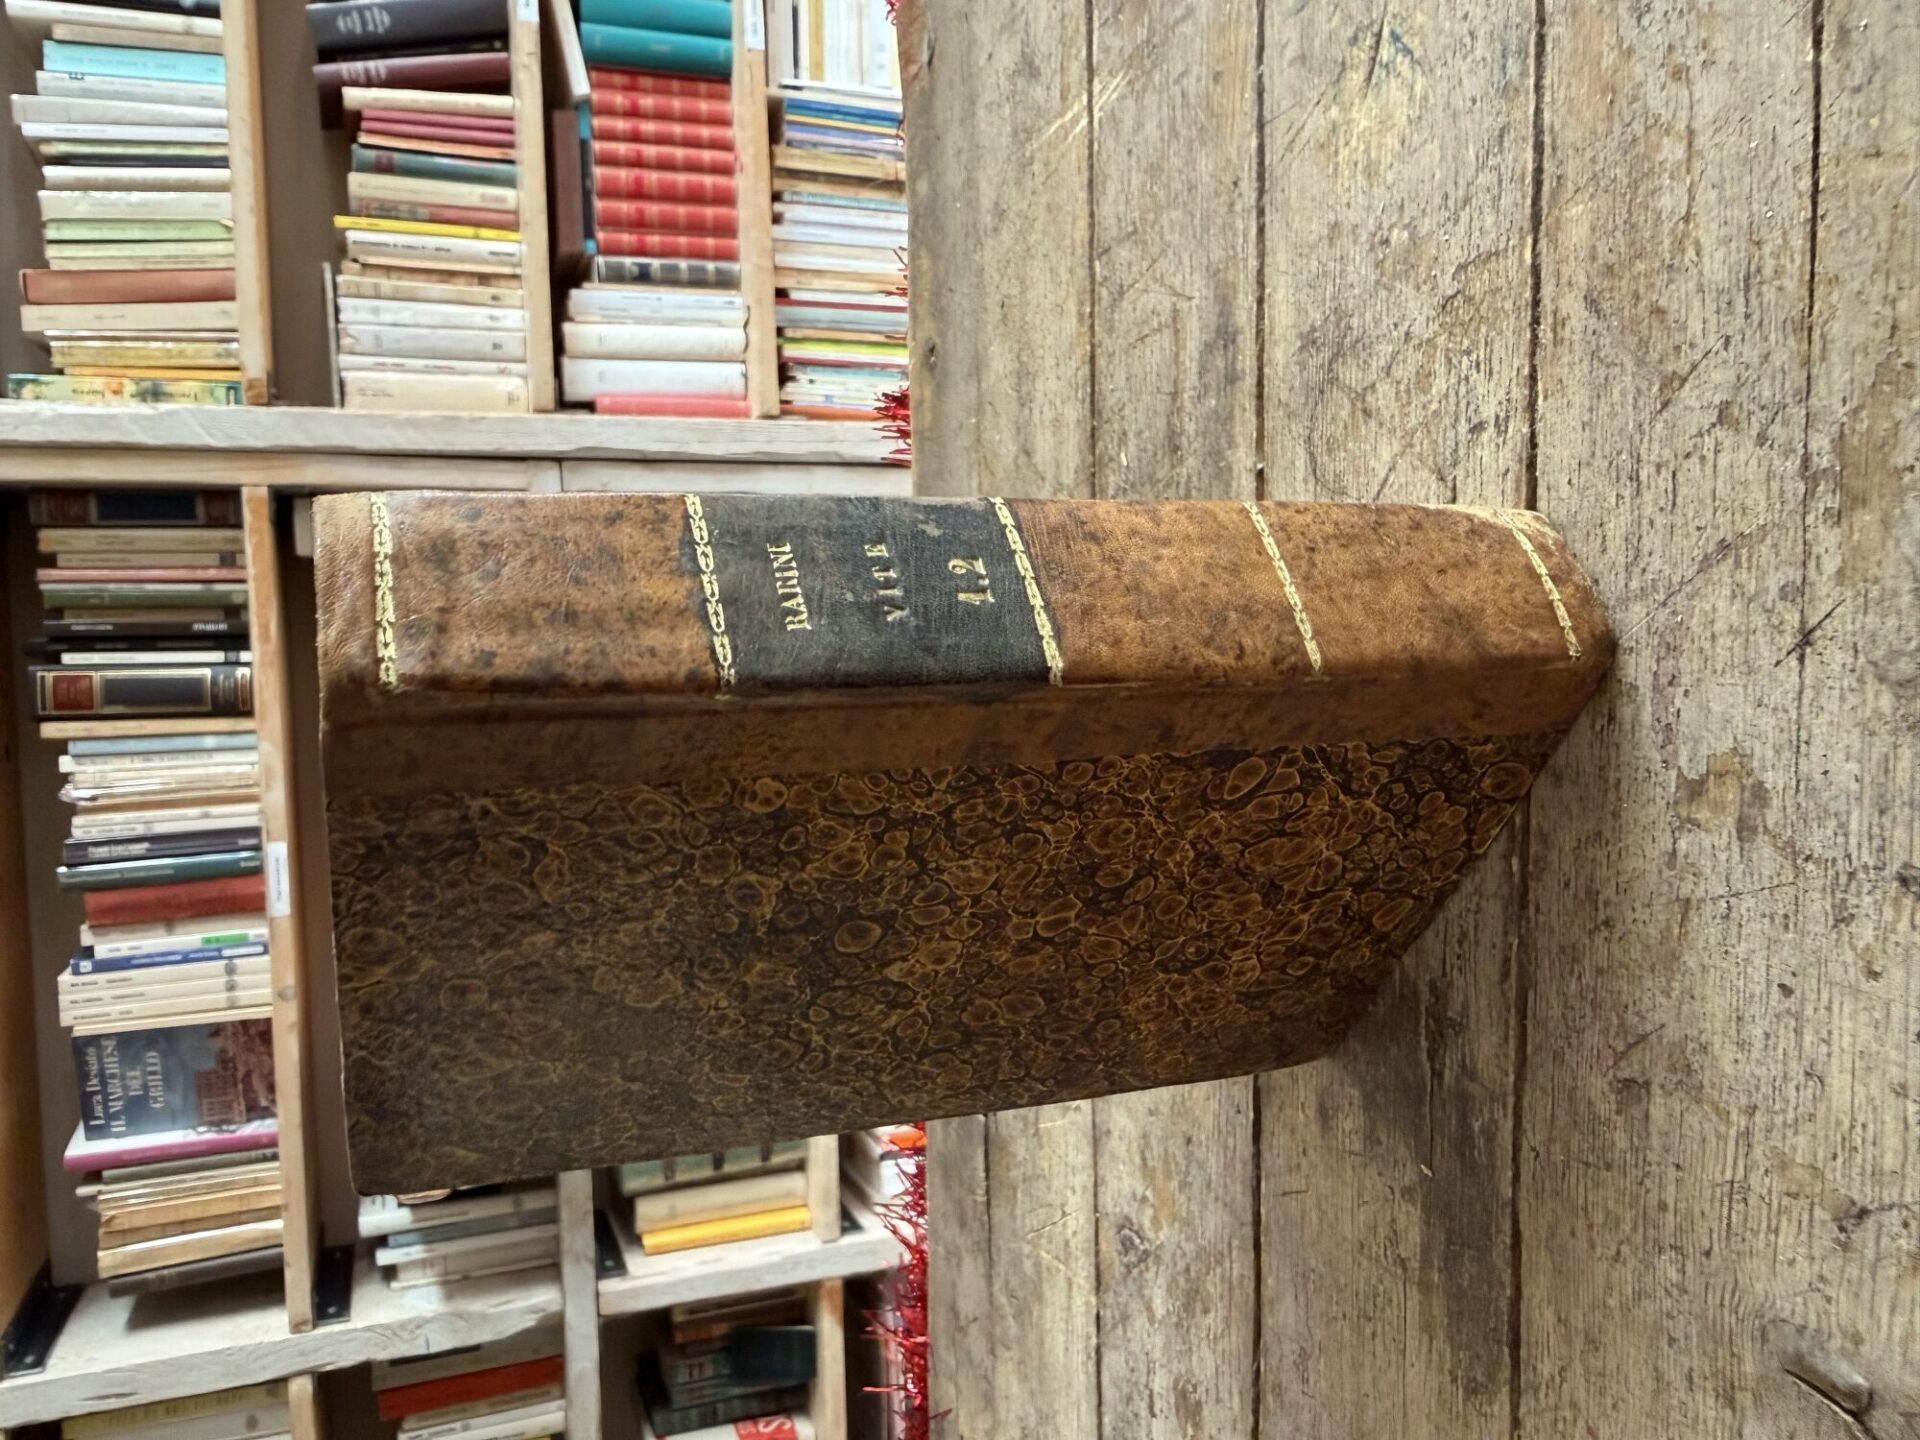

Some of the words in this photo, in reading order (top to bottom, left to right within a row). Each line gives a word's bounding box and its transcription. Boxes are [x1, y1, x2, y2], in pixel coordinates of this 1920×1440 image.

[863, 543, 911, 624] VITE
[100, 1037, 124, 1114] MARCHESE
[126, 1065, 144, 1096] DEL
[145, 1050, 166, 1108] GRILLO
[89, 1094, 105, 1126] Luca
